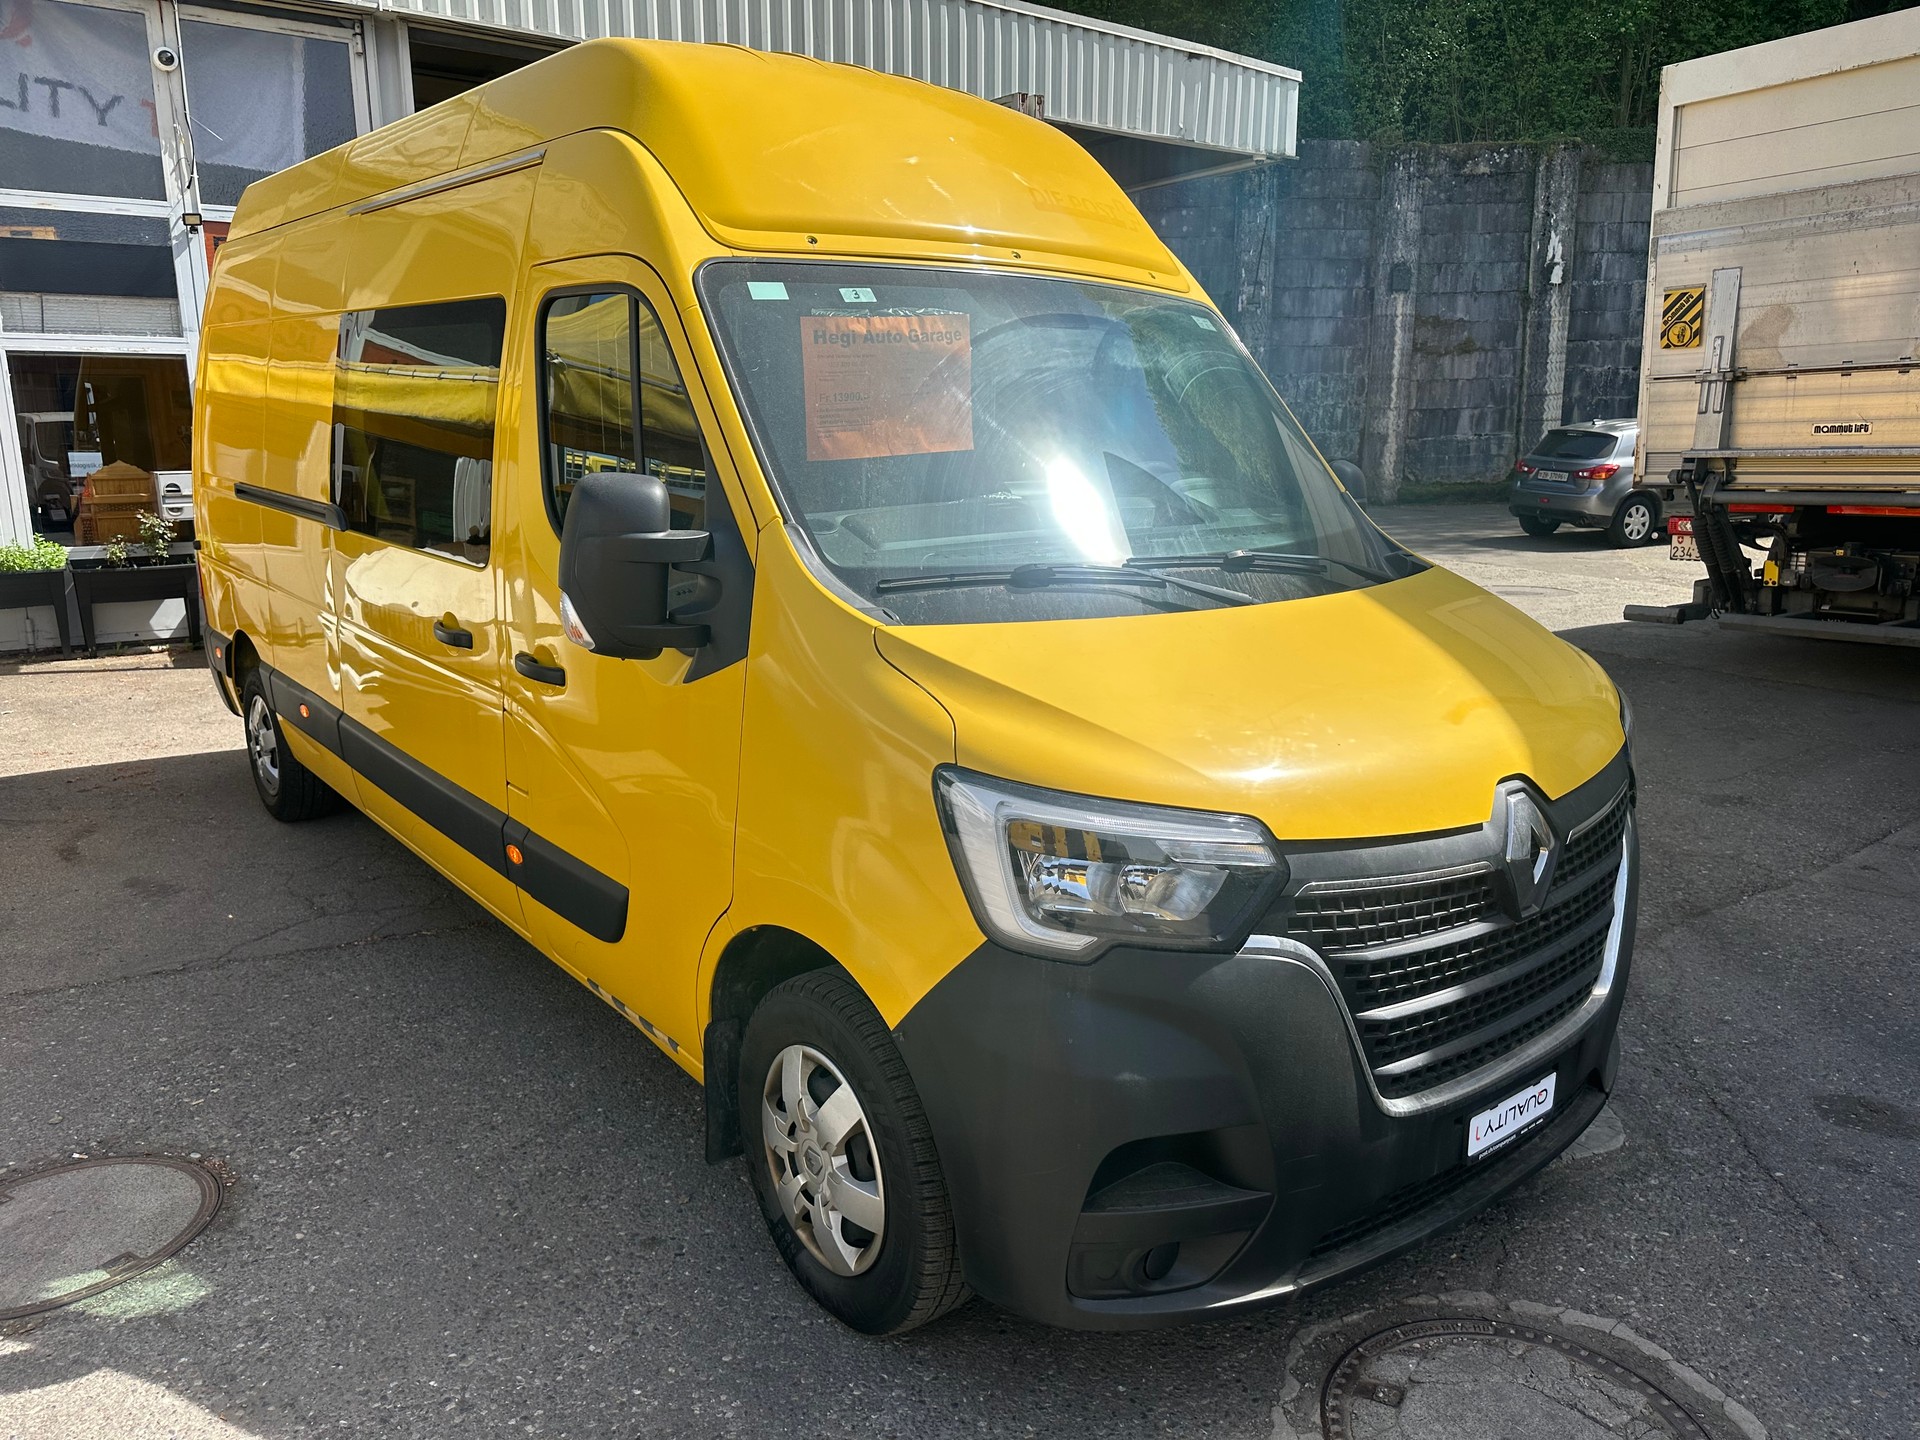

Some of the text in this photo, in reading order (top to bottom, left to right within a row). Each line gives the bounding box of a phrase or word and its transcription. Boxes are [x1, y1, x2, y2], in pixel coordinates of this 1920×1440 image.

[852, 289, 860, 299] 3
[813, 328, 962, 348] Hegi Auto Garage
[1814, 424, 1870, 434] mammut lift
[1483, 1088, 1548, 1137] QUALITY
